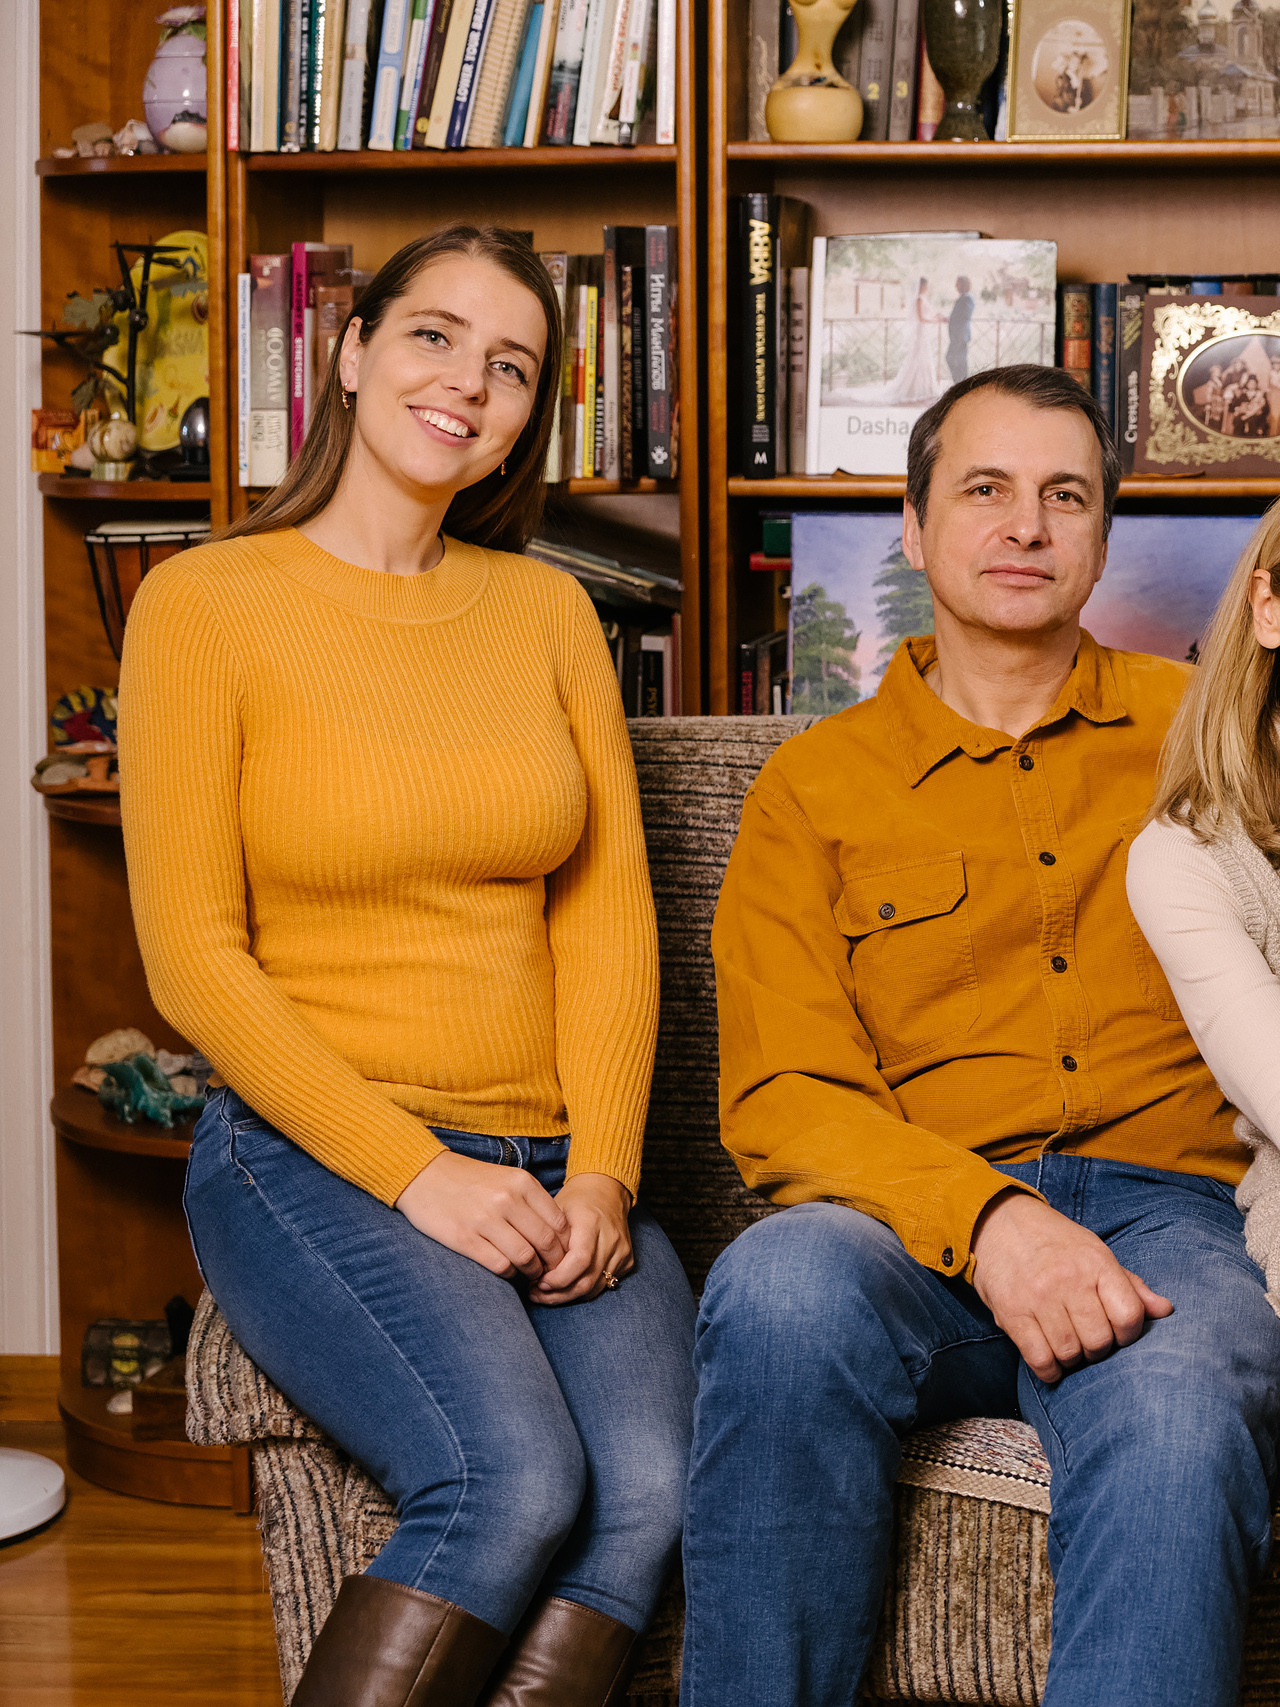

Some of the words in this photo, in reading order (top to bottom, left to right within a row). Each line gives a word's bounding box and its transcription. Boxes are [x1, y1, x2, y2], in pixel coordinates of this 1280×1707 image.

[867, 82, 880, 100] 2
[895, 80, 909, 98] 3
[749, 219, 772, 285] ABBA
[266, 327, 285, 403] ATWOOD
[847, 415, 910, 436] Dasha
[1123, 370, 1139, 443] Стендаль
